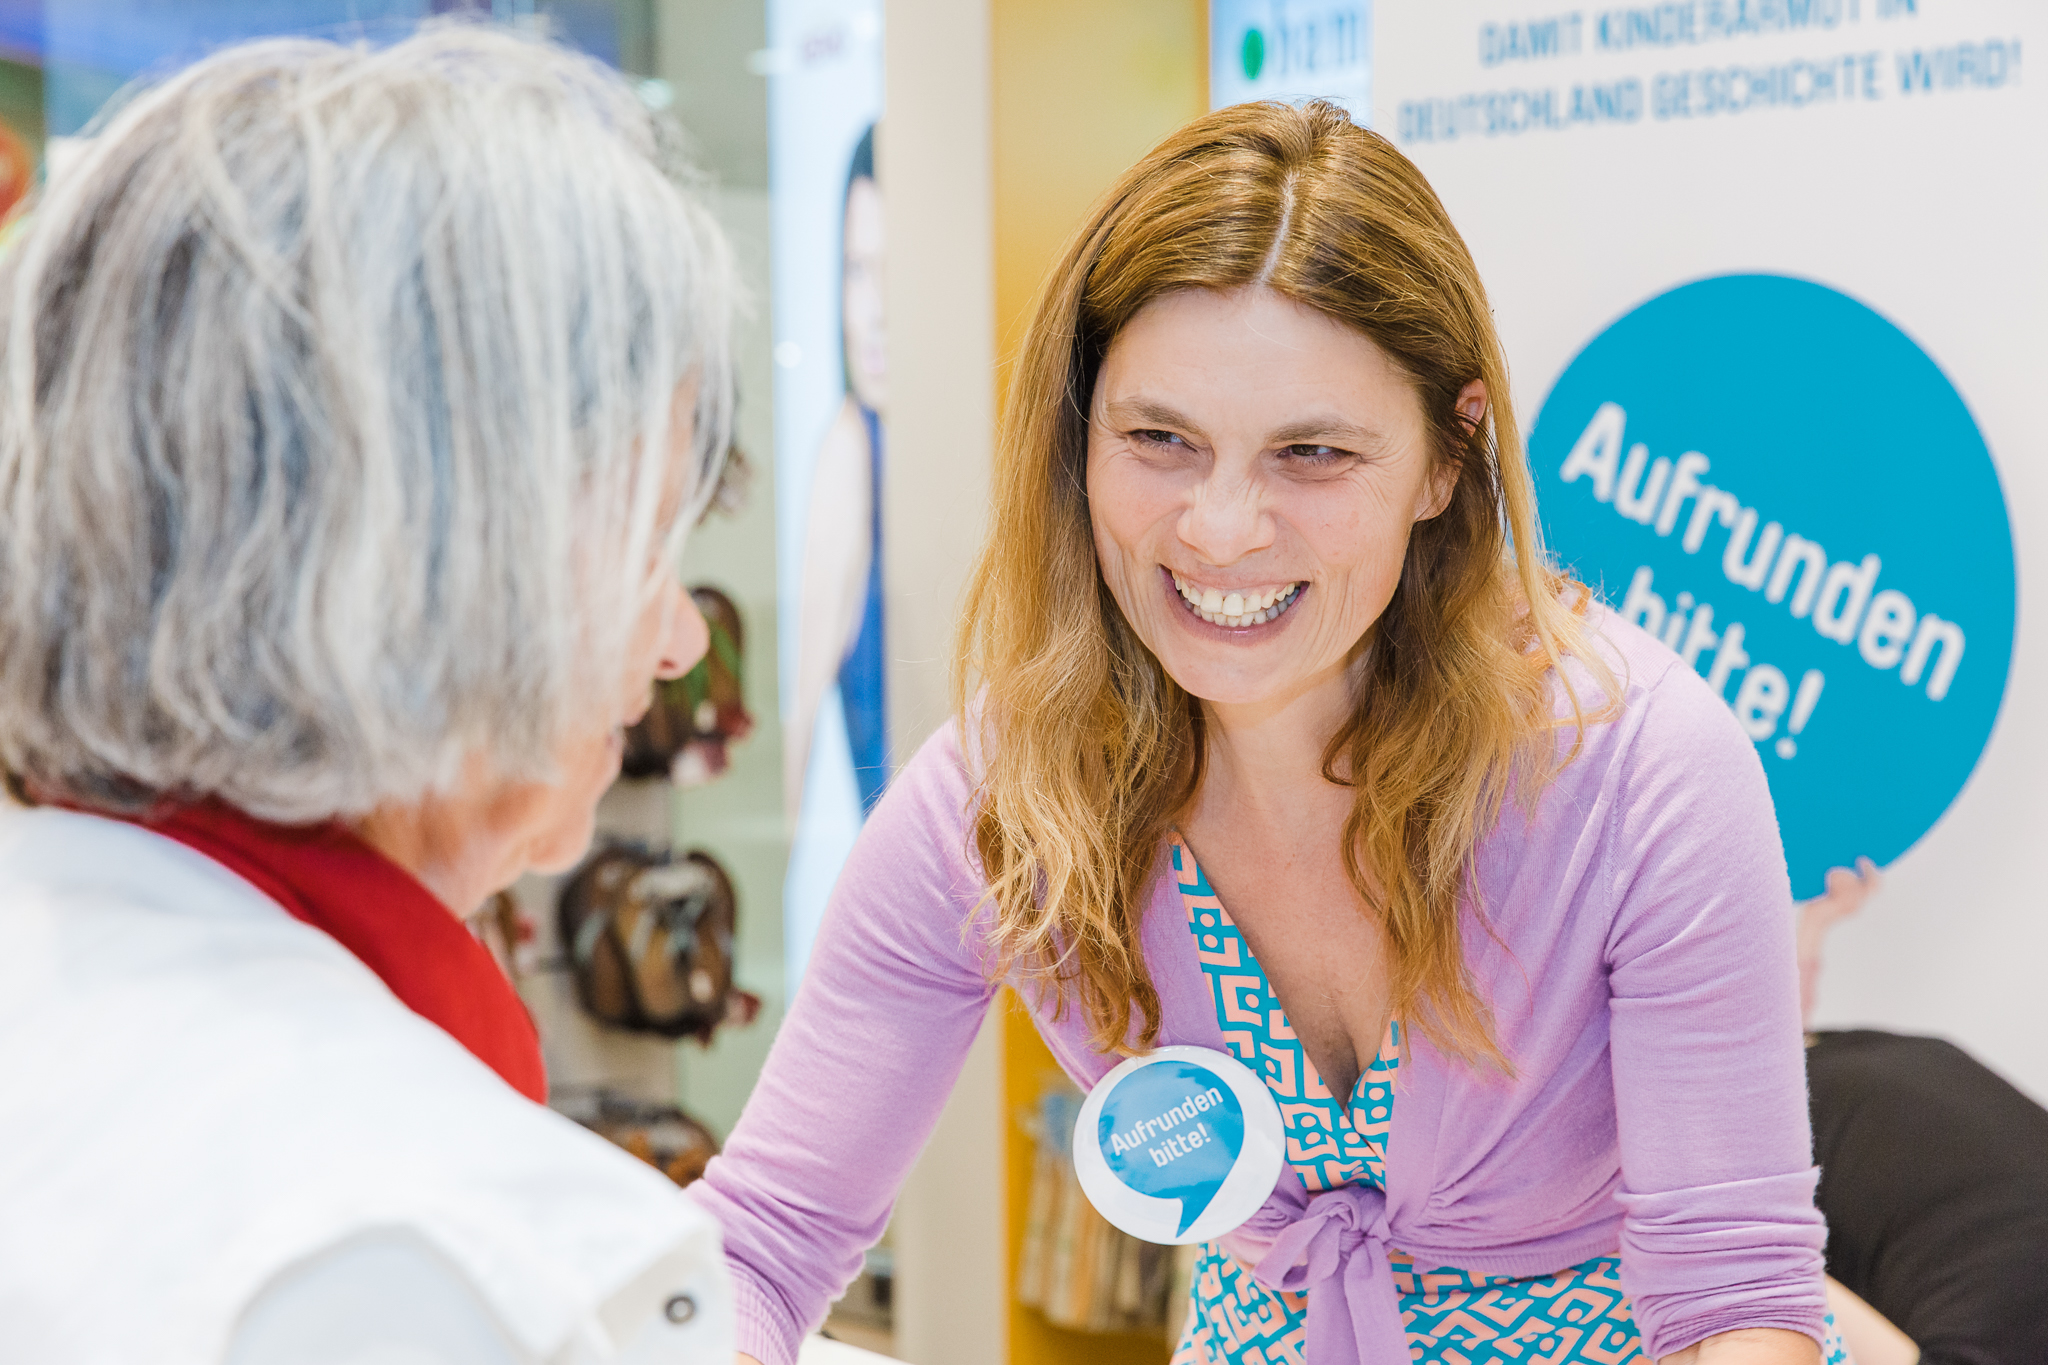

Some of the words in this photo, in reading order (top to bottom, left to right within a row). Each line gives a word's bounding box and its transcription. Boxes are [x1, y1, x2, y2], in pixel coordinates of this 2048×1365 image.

[1478, 12, 1584, 68] DAMIT
[1397, 77, 1644, 145] DEUTSCHLAND
[1651, 51, 1883, 121] GESCHICHTE
[1895, 38, 2022, 95] WIRD!
[1560, 401, 1966, 702] Aufrunden
[1622, 565, 1825, 759] bitte!
[1110, 1087, 1224, 1156] Aufrunden
[1148, 1122, 1212, 1168] bitte!
